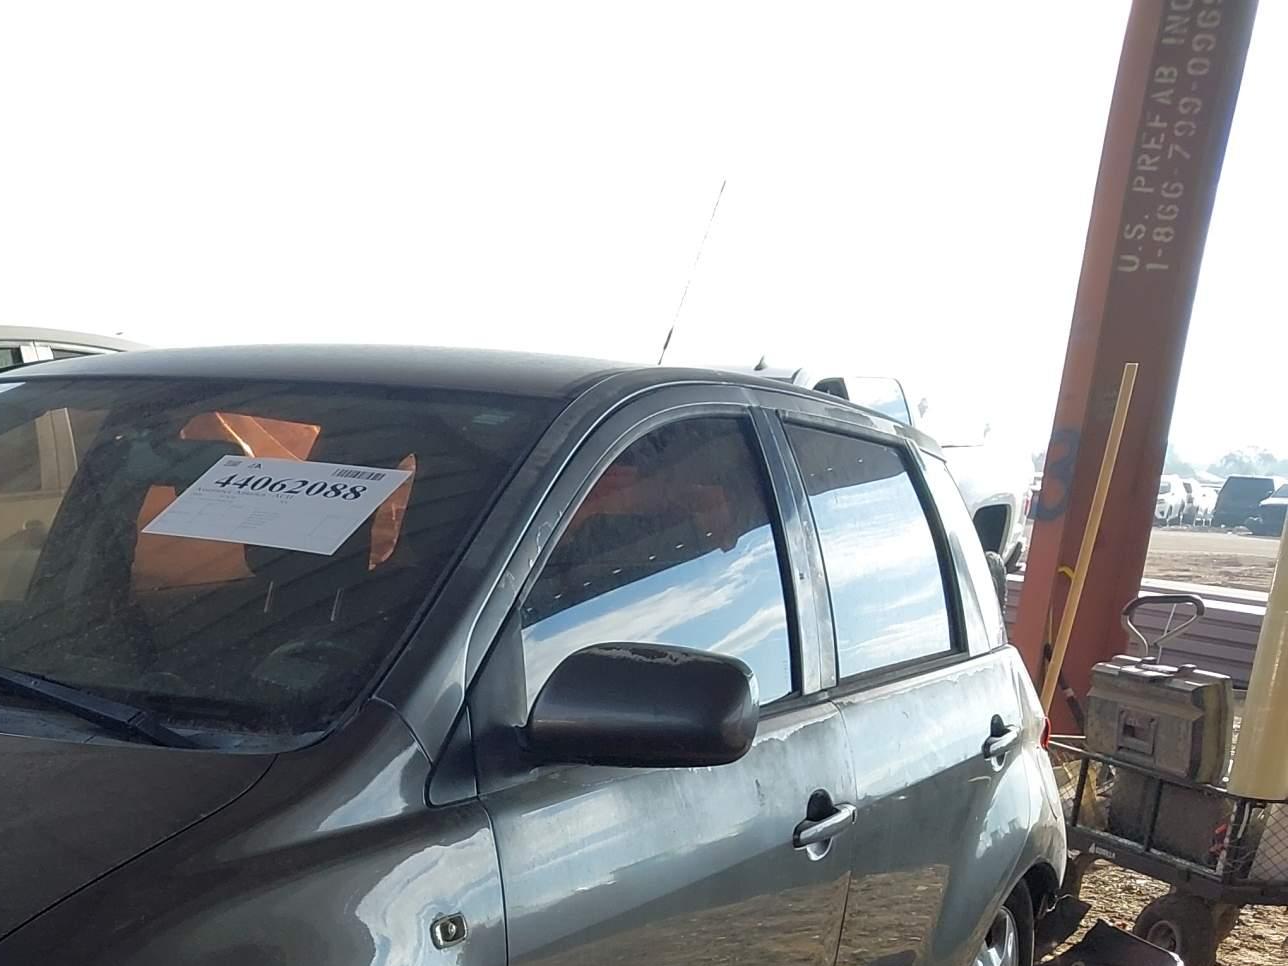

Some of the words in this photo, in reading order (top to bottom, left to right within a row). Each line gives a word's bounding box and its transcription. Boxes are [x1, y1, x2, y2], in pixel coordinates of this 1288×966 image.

[1132, 65, 1179, 193] PREFAB
[1145, 0, 1223, 271] 1-866-799-096
[1117, 213, 1150, 272] U.S.
[214, 473, 368, 501] 44062088
